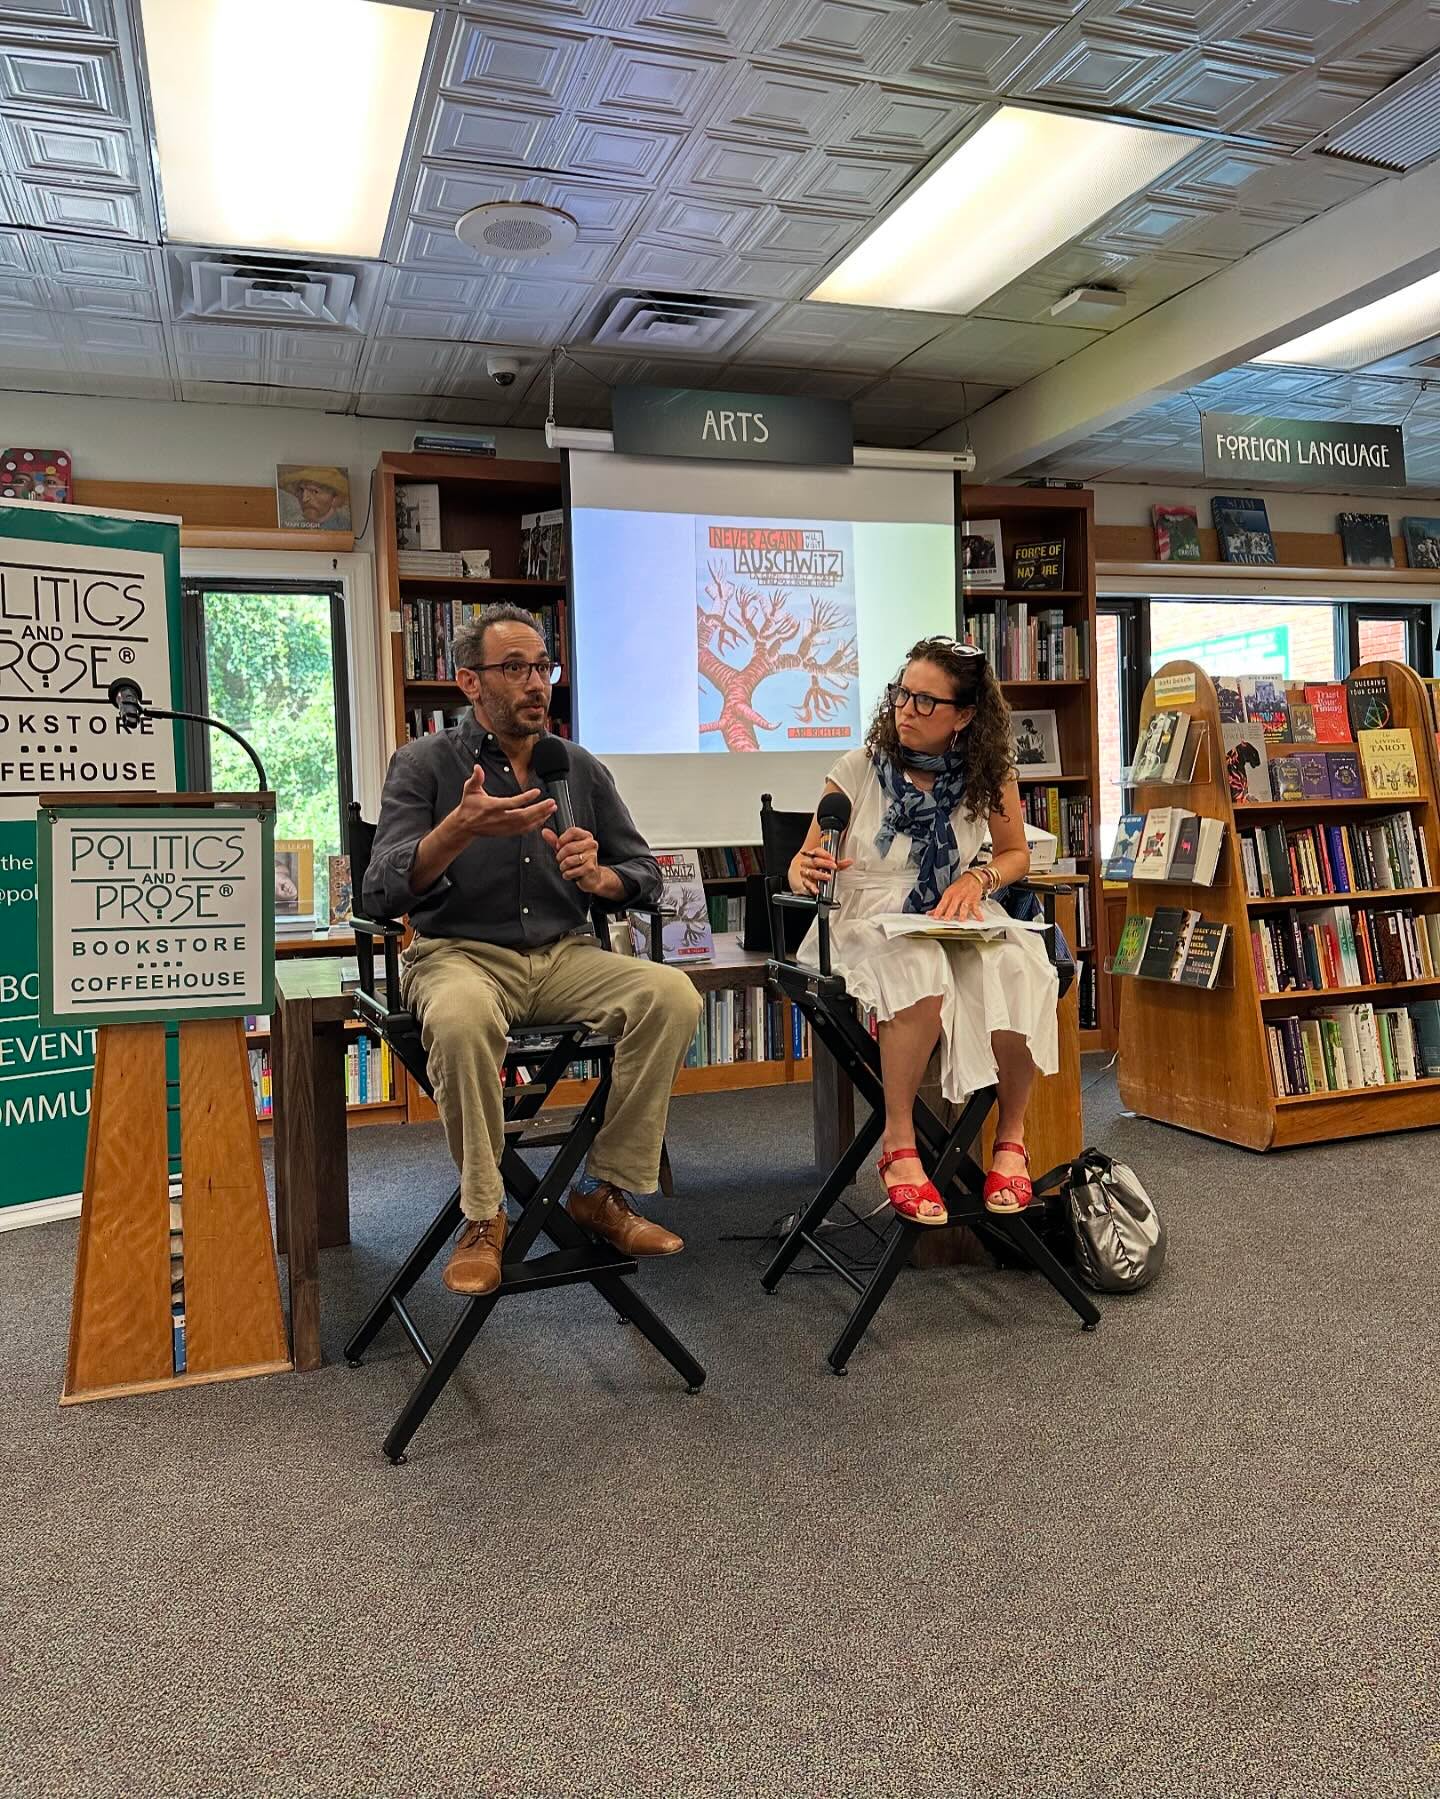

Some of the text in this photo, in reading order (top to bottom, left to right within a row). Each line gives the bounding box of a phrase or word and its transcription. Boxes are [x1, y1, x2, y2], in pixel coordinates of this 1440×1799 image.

[702, 410, 769, 444] ARTS
[1216, 434, 1390, 468] FOREIGN LANGUAGE
[713, 528, 800, 550] NEVER AGAIN
[1016, 544, 1062, 560] FORCE OF
[1, 573, 145, 631] LITICS
[22, 625, 64, 641] AND
[1350, 687, 1387, 696] YOUR CRAFT
[1354, 679, 1386, 688] QUEERING
[1370, 744, 1407, 753] TAROT
[2, 762, 156, 781] FEEHOUSE
[1, 854, 34, 871] the
[72, 835, 245, 873] POLITICS
[142, 873, 176, 885] AND
[72, 937, 246, 957] BOOKSTORE
[71, 971, 246, 992] COFFEEHOUSE
[0, 1088, 91, 1127] MMU
